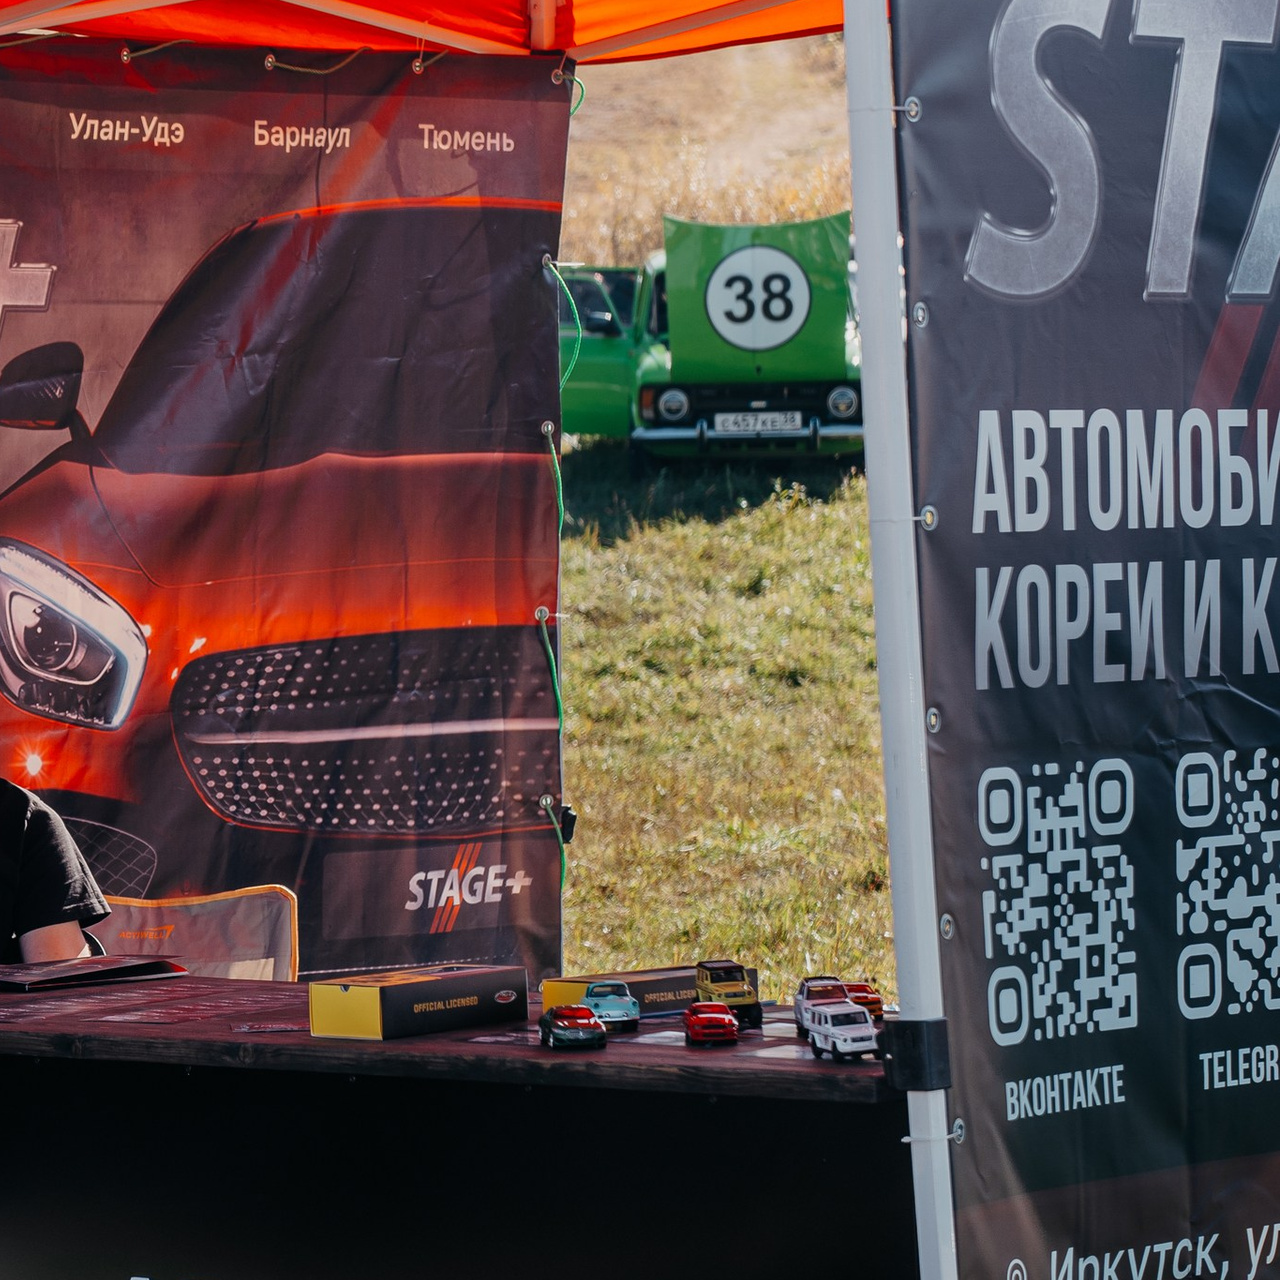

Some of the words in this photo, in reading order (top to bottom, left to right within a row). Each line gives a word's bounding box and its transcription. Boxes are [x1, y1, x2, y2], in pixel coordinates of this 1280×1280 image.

[69, 112, 185, 146] Улан-Удэ
[254, 120, 351, 154] Барнаул
[418, 123, 515, 152] Тюмень
[723, 273, 794, 324] 38
[1184, 559, 1220, 678] И
[405, 865, 533, 911] STAGE+
[413, 1000, 445, 1013] OFFICIAL
[446, 996, 478, 1008] LICENSED
[644, 991, 675, 1003] OFFICIAL
[1199, 1044, 1280, 1091] TELEGR
[1005, 1065, 1125, 1121] ВКОНТАКТЕ
